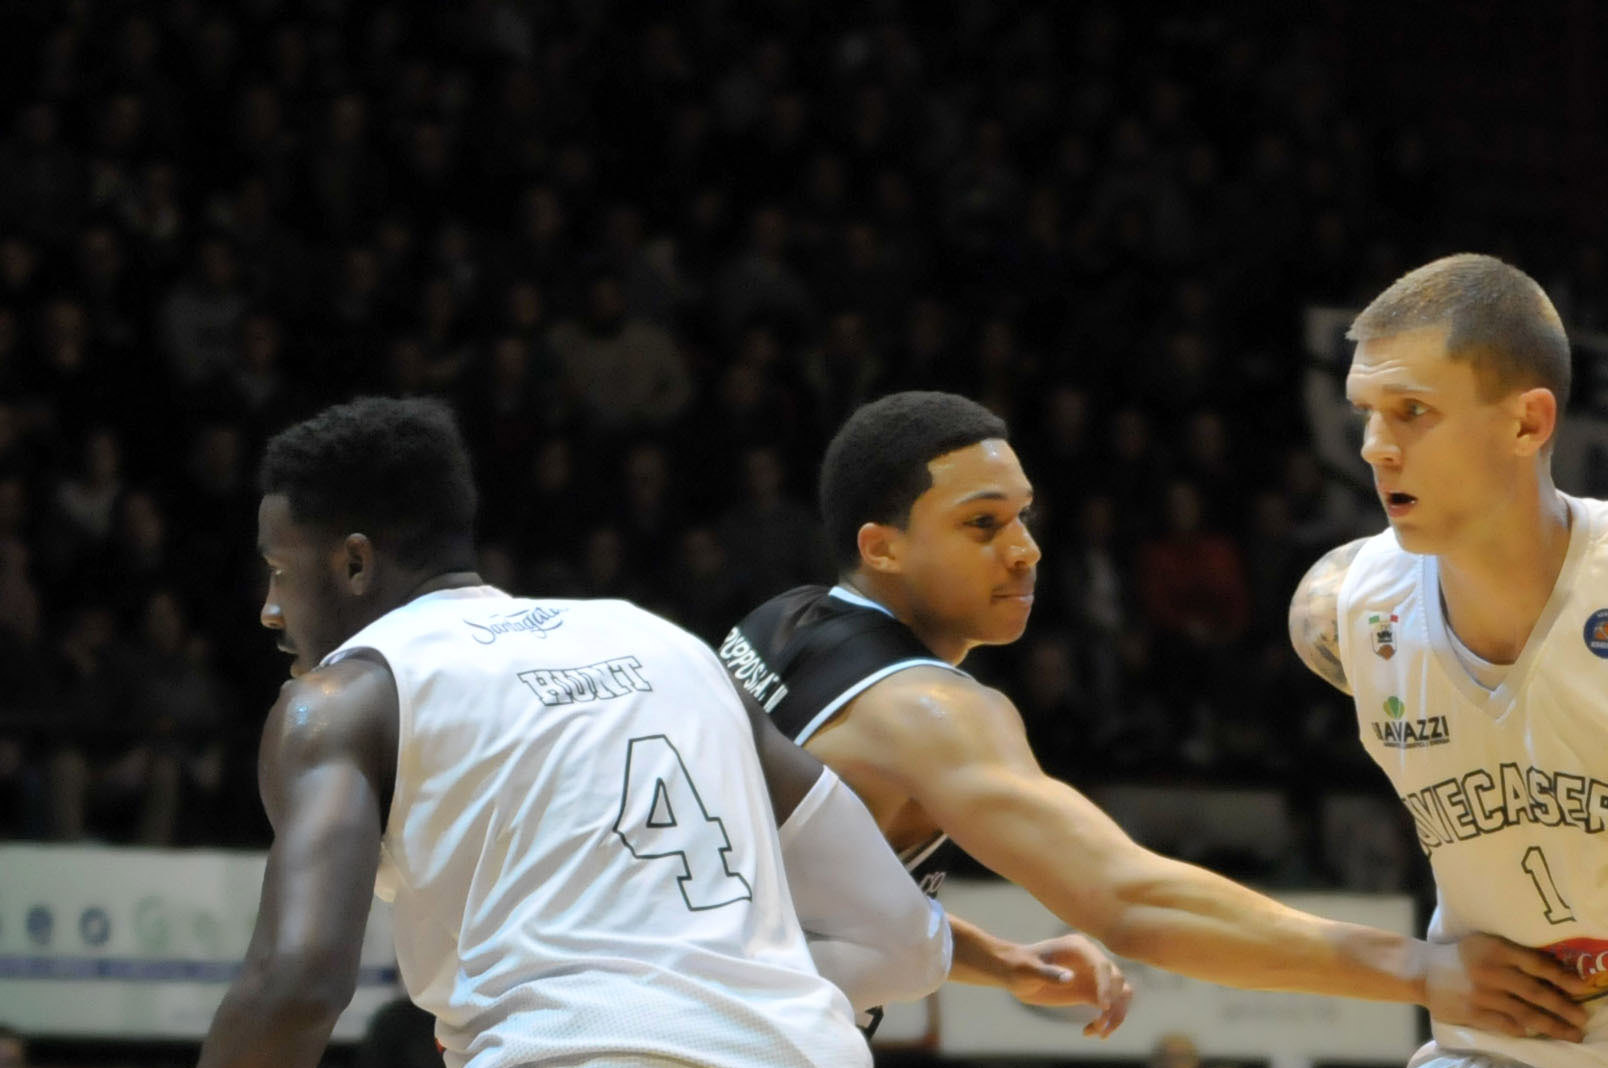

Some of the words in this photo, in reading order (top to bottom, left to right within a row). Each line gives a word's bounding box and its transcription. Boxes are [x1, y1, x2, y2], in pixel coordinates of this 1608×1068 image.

[517, 655, 653, 706] HUNT
[612, 734, 753, 912] 4
[1521, 846, 1577, 925] 1
